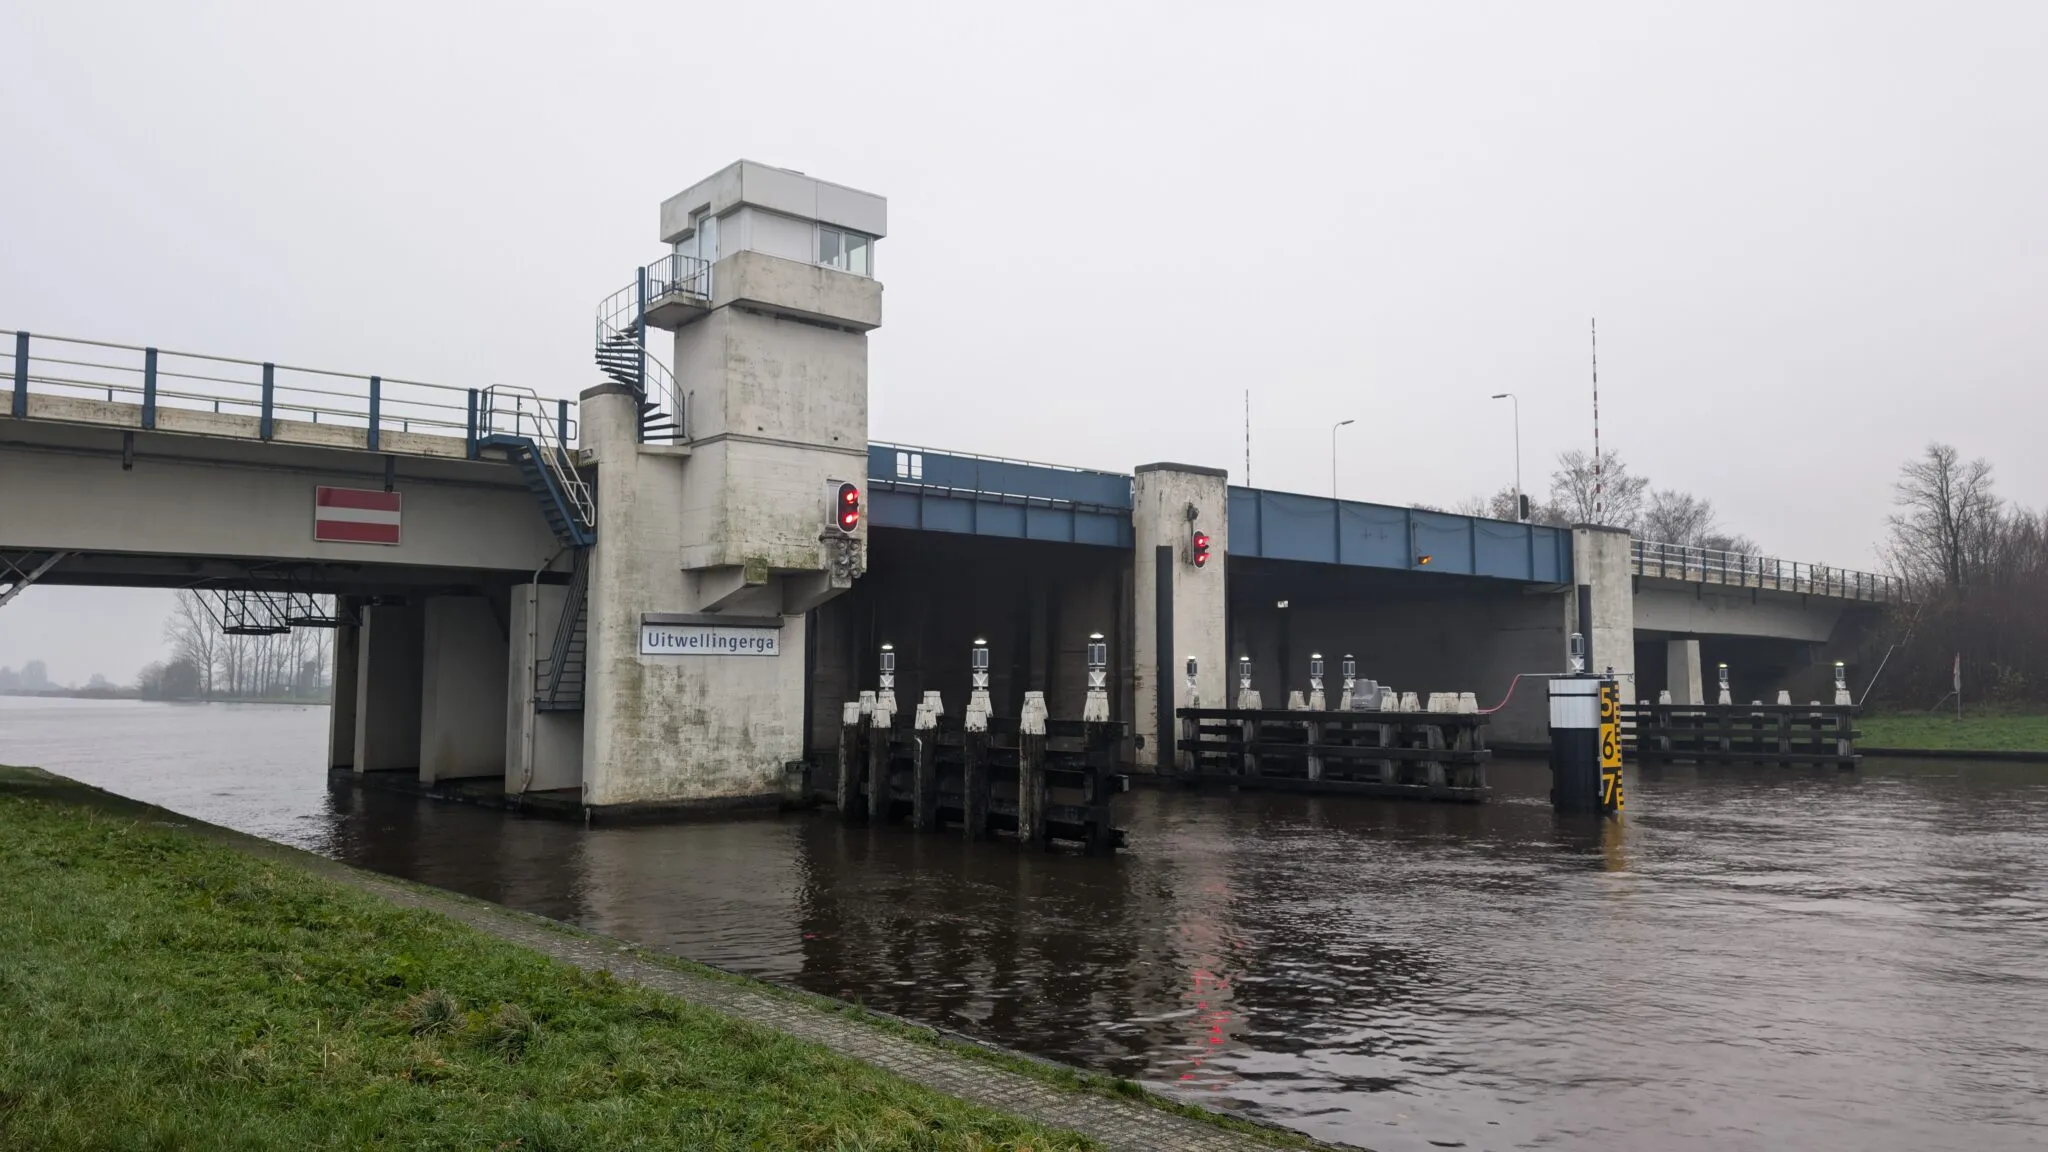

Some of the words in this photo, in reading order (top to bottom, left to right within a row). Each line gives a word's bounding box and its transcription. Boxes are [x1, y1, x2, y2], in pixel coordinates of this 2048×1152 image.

[648, 632, 774, 653] Uitwellingerga
[1600, 687, 1613, 717] 5
[1602, 731, 1614, 760] 6
[1602, 773, 1615, 805] 7
